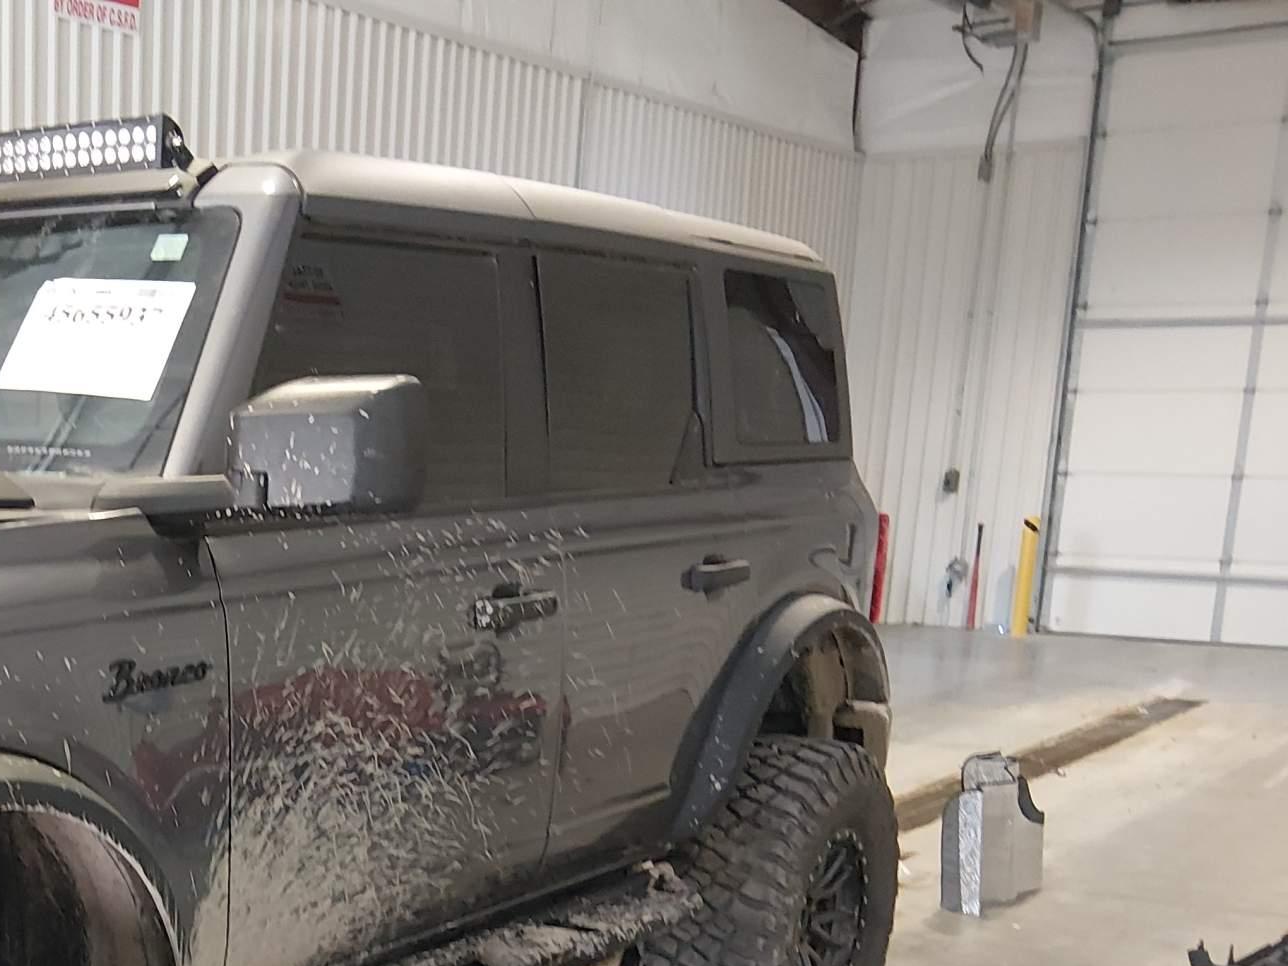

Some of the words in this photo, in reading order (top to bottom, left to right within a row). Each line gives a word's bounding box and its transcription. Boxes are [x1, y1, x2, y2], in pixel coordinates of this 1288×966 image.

[66, 0, 95, 20] ORDER
[96, 3, 108, 23] OF
[102, 659, 213, 703] Bronco
